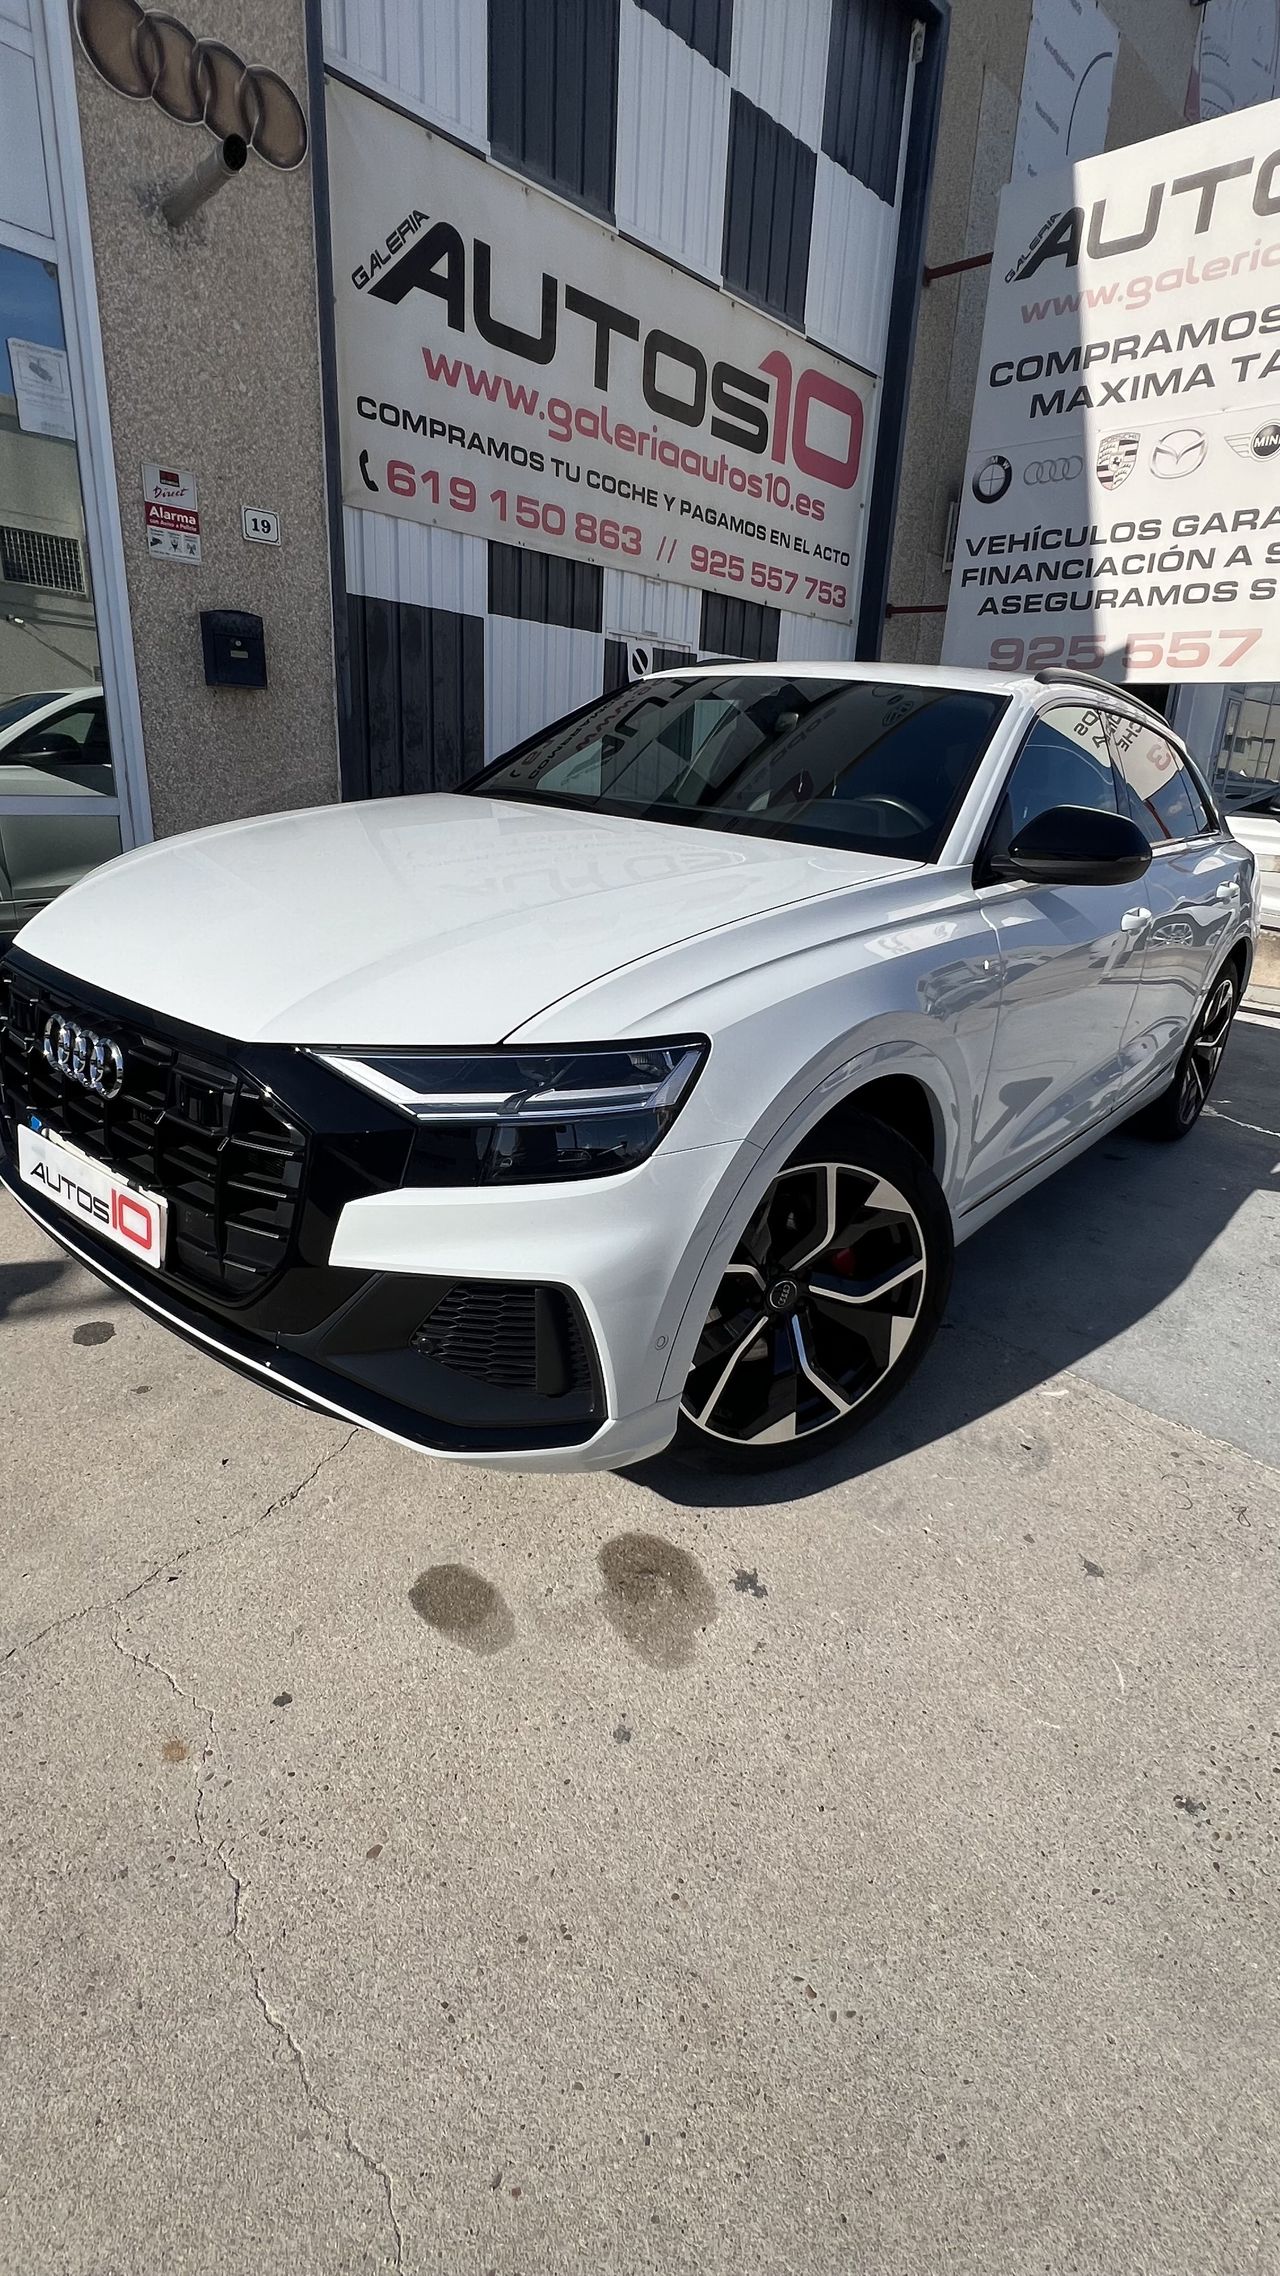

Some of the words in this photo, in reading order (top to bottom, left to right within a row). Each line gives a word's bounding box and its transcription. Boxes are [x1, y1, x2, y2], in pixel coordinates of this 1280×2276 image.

[351, 210, 430, 290] GALERIA
[1004, 211, 1063, 284] GALERIA
[989, 303, 1280, 388] COMPRAMOS
[1029, 362, 1216, 419] MAXIMA
[1231, 348, 1280, 383] TA
[421, 346, 826, 522] www.galeriaautos10.es
[149, 505, 197, 525] Alarma
[356, 395, 545, 473] COMPRAMOS
[550, 457, 581, 484] TU
[586, 469, 659, 508] COCHE
[663, 493, 676, 513] Y
[680, 499, 767, 542] PAGAMOS
[770, 529, 792, 550] EN
[793, 536, 811, 556] EL
[813, 546, 851, 568] ACTO
[251, 517, 272, 534] 19
[386, 459, 477, 513] 619
[489, 488, 566, 536] 150
[575, 511, 642, 556] 863
[690, 544, 745, 583] 925
[750, 561, 799, 596] 557
[804, 576, 848, 609] 753
[965, 518, 1162, 557] VEHÍCULOS
[1172, 506, 1280, 538] GARA
[961, 544, 1217, 588] FINANCIACIÓN
[1223, 545, 1253, 569] A
[977, 580, 1239, 617] ASEGURAMOS
[987, 635, 1107, 672] 925
[1121, 628, 1263, 670] 557
[30, 1162, 153, 1250] AUTOS10
